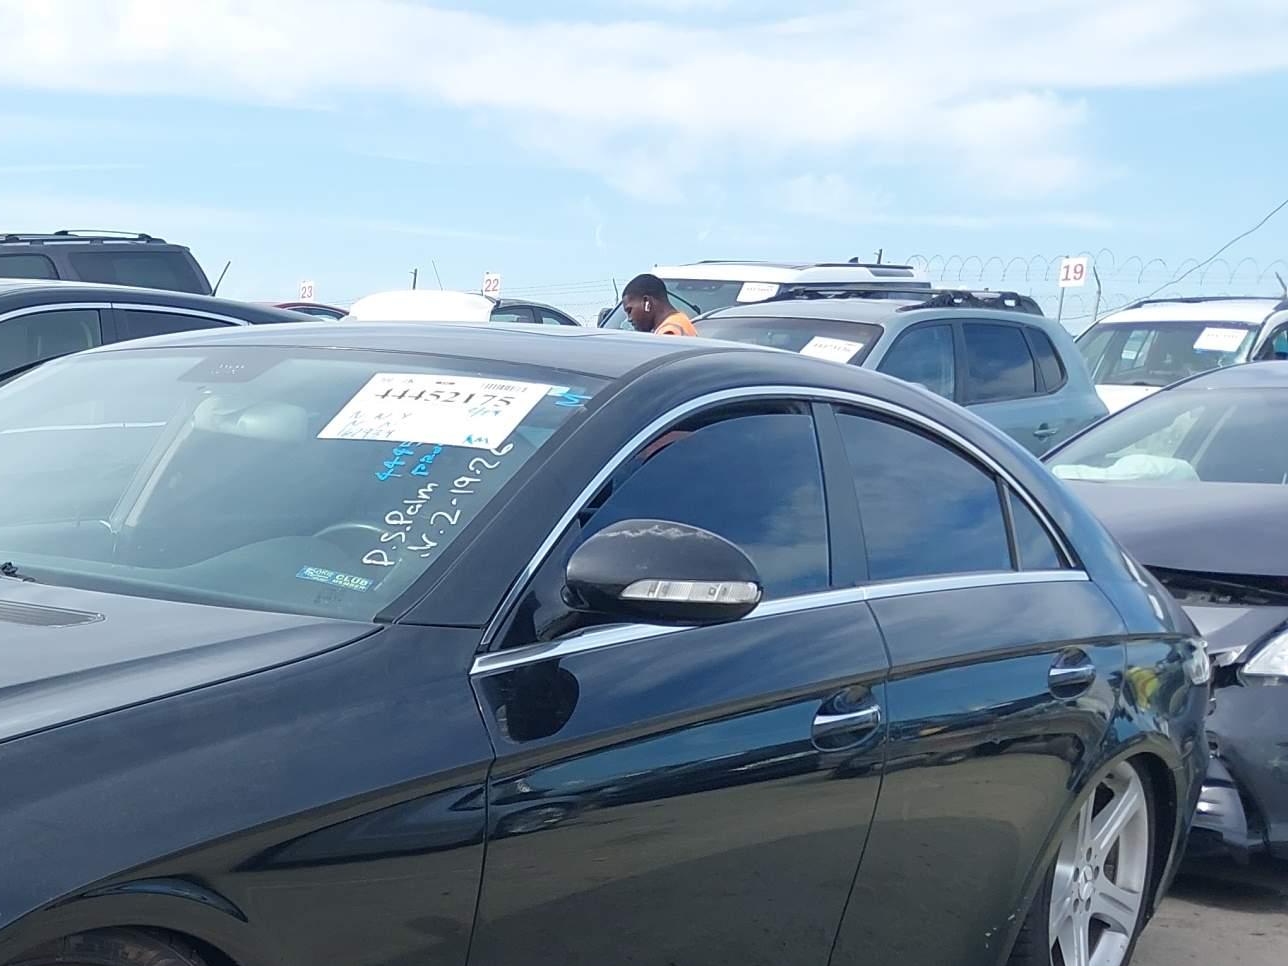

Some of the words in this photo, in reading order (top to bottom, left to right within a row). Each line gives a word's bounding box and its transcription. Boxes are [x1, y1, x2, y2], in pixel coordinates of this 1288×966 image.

[1061, 263, 1084, 281] 19
[301, 286, 313, 299] 23
[484, 278, 500, 292] 22
[375, 387, 516, 408] 44452175
